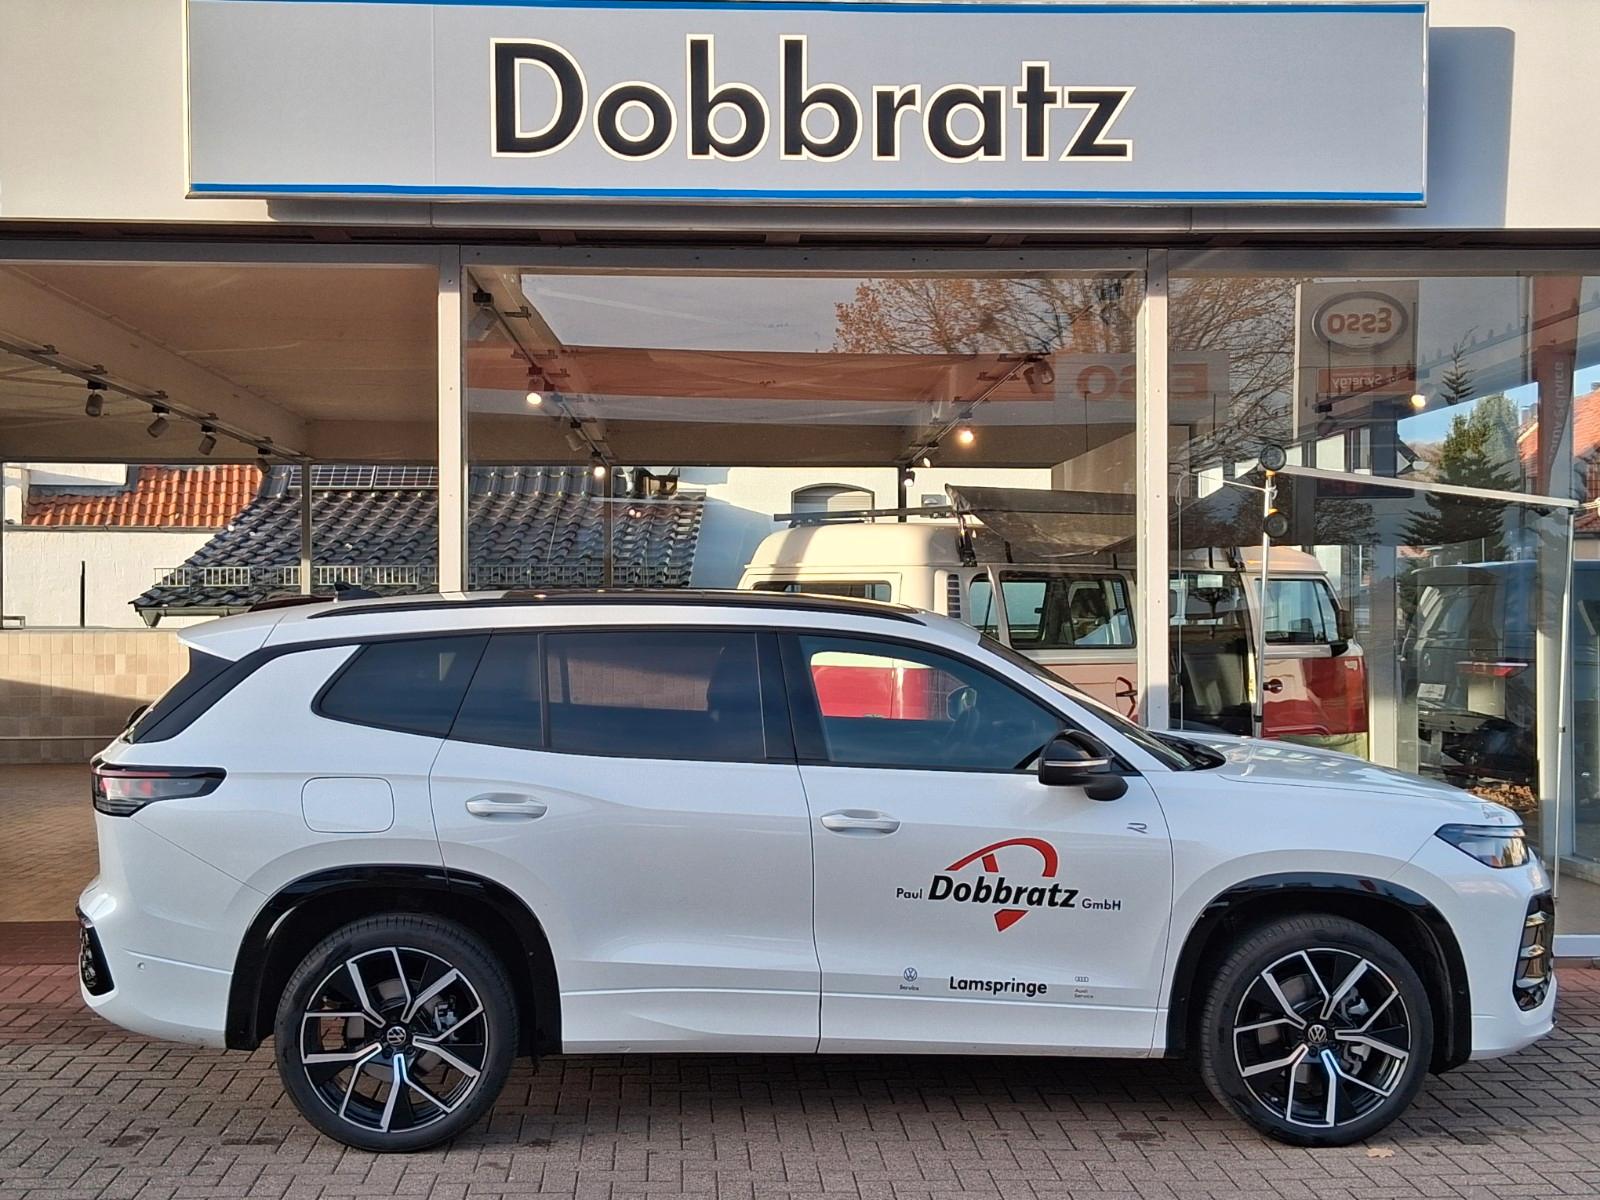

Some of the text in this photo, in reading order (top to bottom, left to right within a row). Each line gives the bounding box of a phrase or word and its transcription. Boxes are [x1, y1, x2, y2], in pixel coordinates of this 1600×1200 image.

[490, 34, 1136, 162] Dobbratz
[896, 874, 1121, 912] Paul Dobbratz GmbH
[949, 975, 1048, 998] Lamspringe
